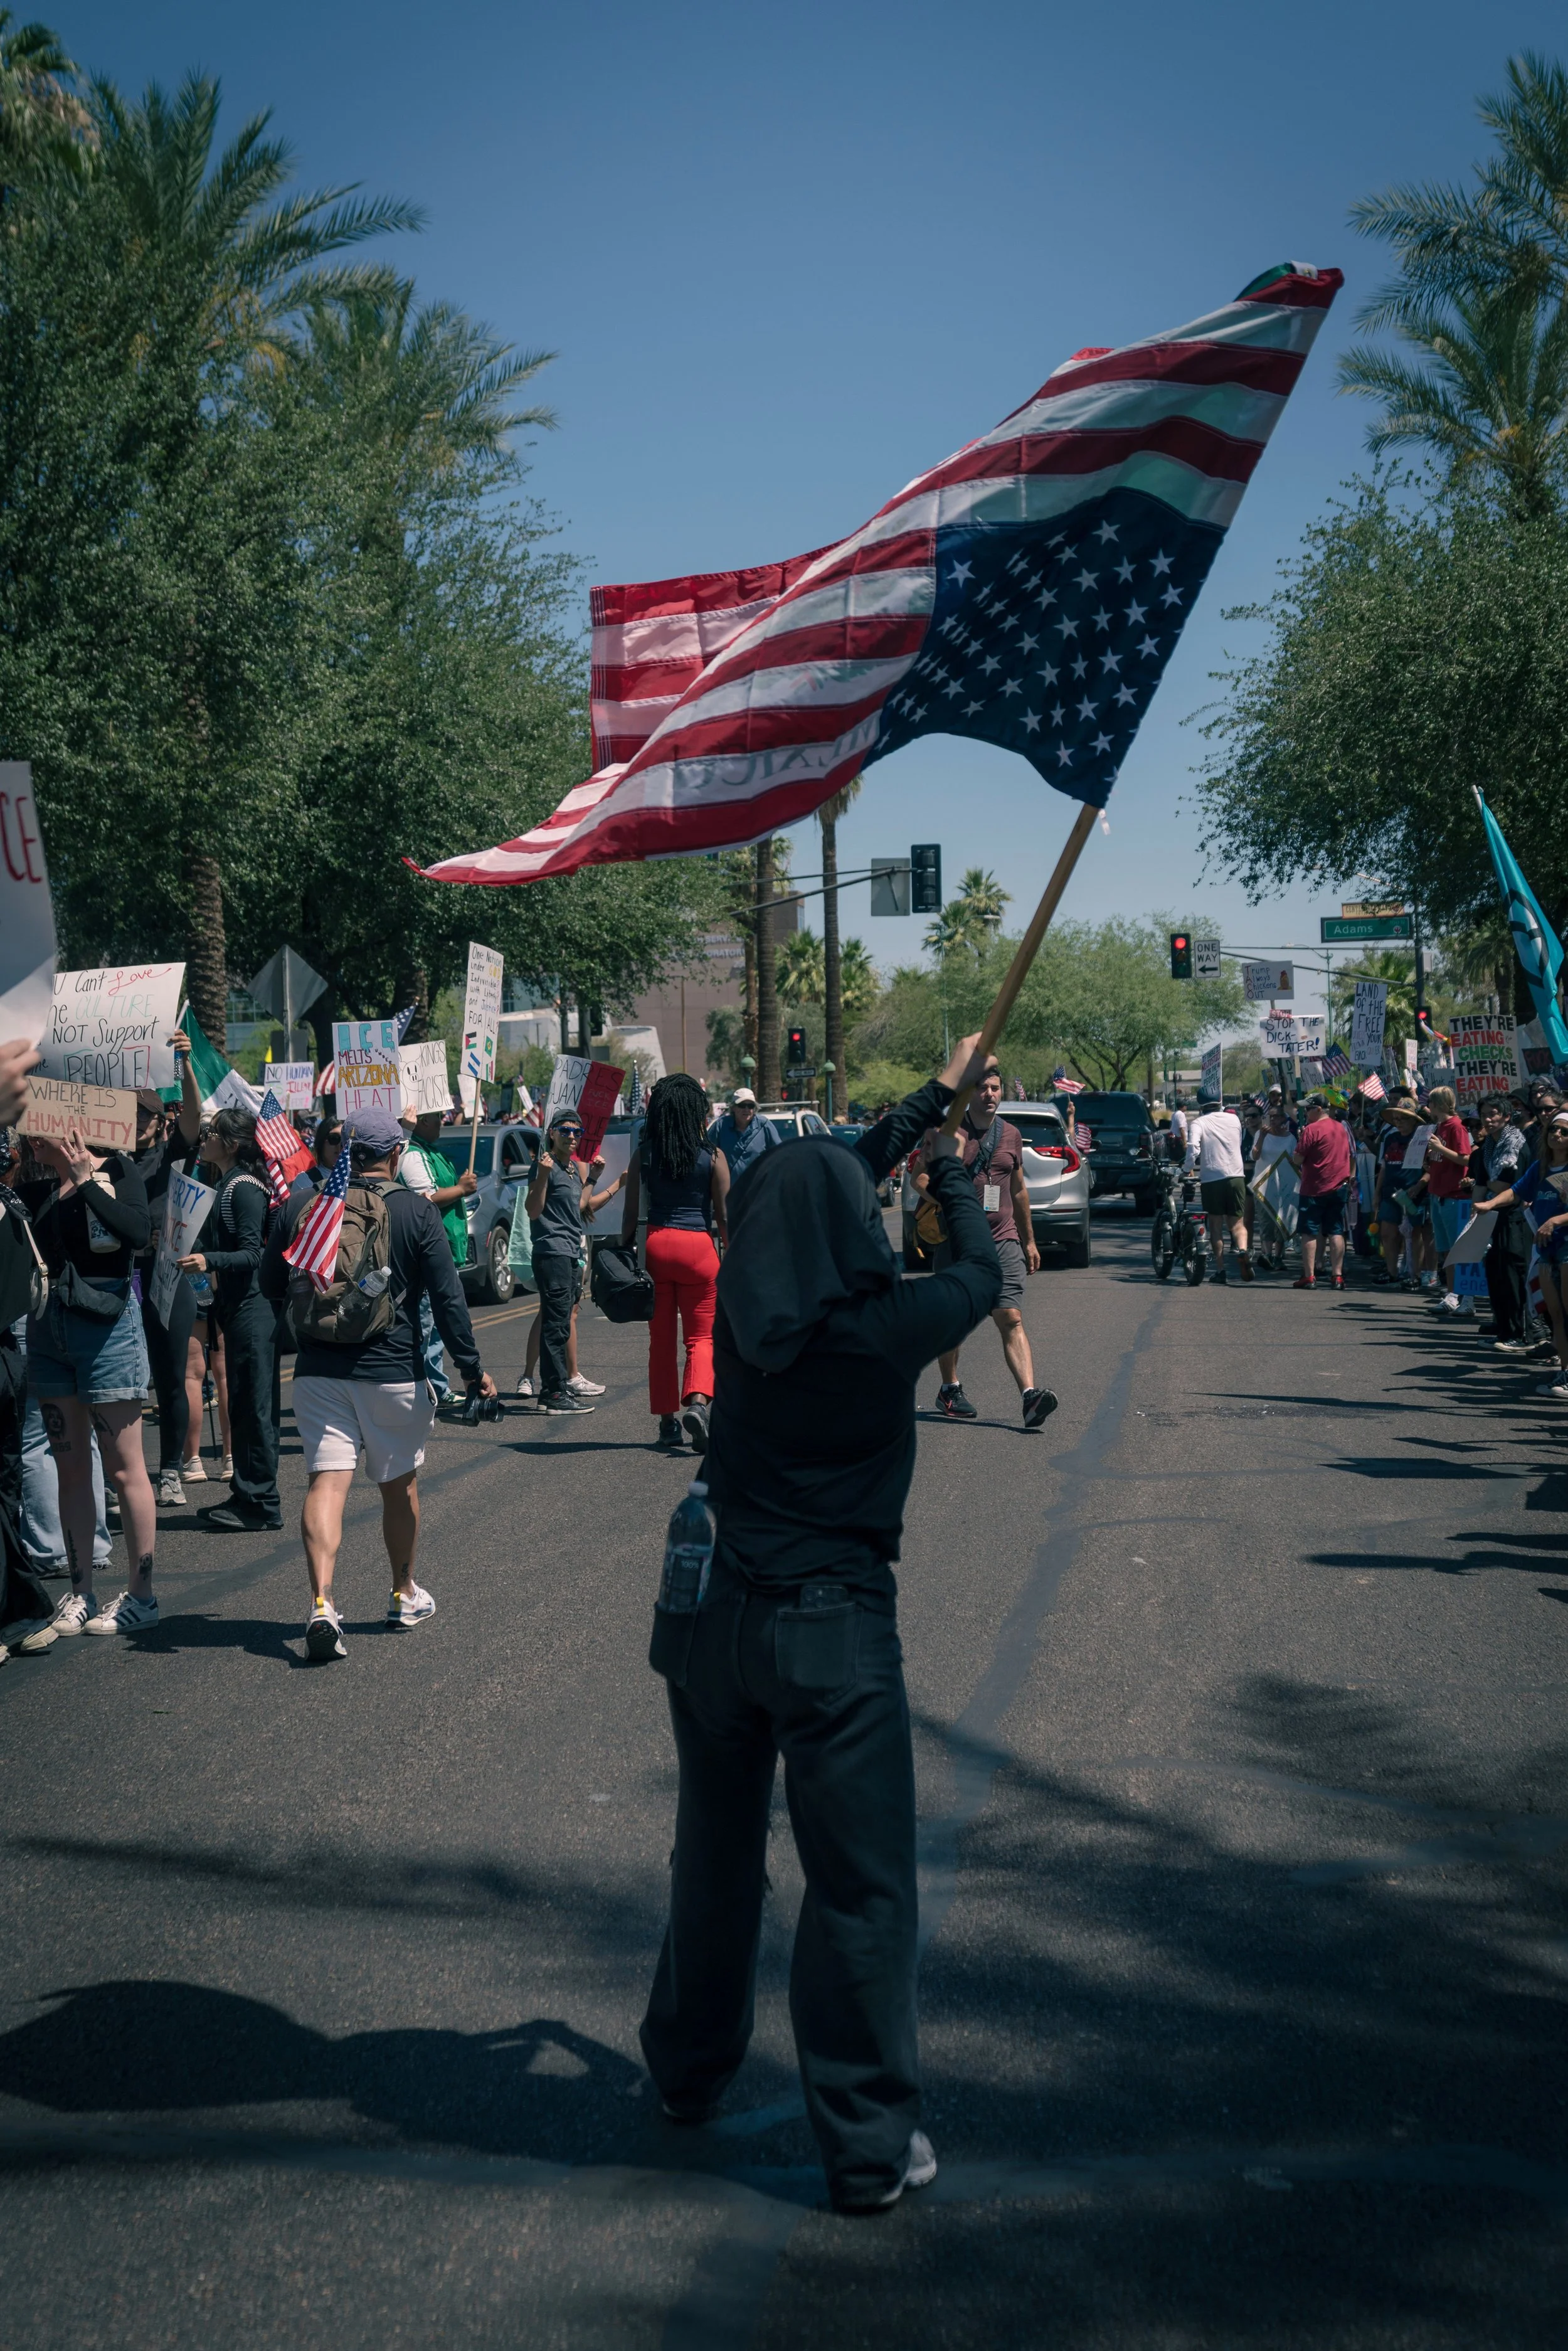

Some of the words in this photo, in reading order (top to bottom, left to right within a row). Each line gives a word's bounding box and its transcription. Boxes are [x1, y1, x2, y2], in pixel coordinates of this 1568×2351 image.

[1334, 925, 1373, 934] Adams
[472, 946, 484, 960] One
[1197, 943, 1217, 952] ONE
[1197, 953, 1217, 962] WAY
[470, 962, 485, 972] under
[489, 964, 501, 980] GOD
[1244, 965, 1270, 975] Trump
[75, 970, 107, 993] Can't
[108, 968, 172, 996] Love
[1246, 975, 1270, 984] Always
[1247, 982, 1277, 991] Chickens
[1247, 989, 1264, 999] OUT
[1356, 982, 1379, 999] LAND
[75, 994, 154, 1020] CULTURE
[469, 996, 478, 1006] and
[469, 1010, 483, 1027] FOR
[1265, 1019, 1294, 1031] STOP
[1299, 1017, 1320, 1027] THE
[1359, 1014, 1381, 1033] FREE
[1450, 1016, 1514, 1032] THEY'RE
[53, 1025, 88, 1044] NOT
[93, 1016, 159, 1053] Support
[337, 1022, 395, 1056] ICE
[1267, 1032, 1296, 1043] DICK-
[1367, 1032, 1382, 1046] YOUR
[1451, 1031, 1504, 1047] EATING
[1278, 1037, 1320, 1053] TATER!
[338, 1049, 372, 1066] MELTS
[374, 1048, 391, 1064] UNDER
[420, 1041, 445, 1067] KINGS
[1458, 1046, 1513, 1061] CHECKS
[67, 1050, 144, 1088] PEOPLE
[267, 1066, 283, 1080] NO
[286, 1066, 312, 1080] HUMAN
[1455, 1059, 1517, 1076] THEY'RE
[337, 1064, 400, 1088] ARIZONA
[1456, 1076, 1509, 1091] EATING
[28, 1078, 88, 1105] WHERE
[93, 1088, 116, 1108] IS
[588, 1089, 610, 1099] FUCK
[344, 1087, 396, 1115] HEAT
[587, 1099, 608, 1109] ICE
[65, 1105, 86, 1115] THE
[26, 1111, 132, 1145] HUMANITY
[681, 1560, 699, 1569] 100%
